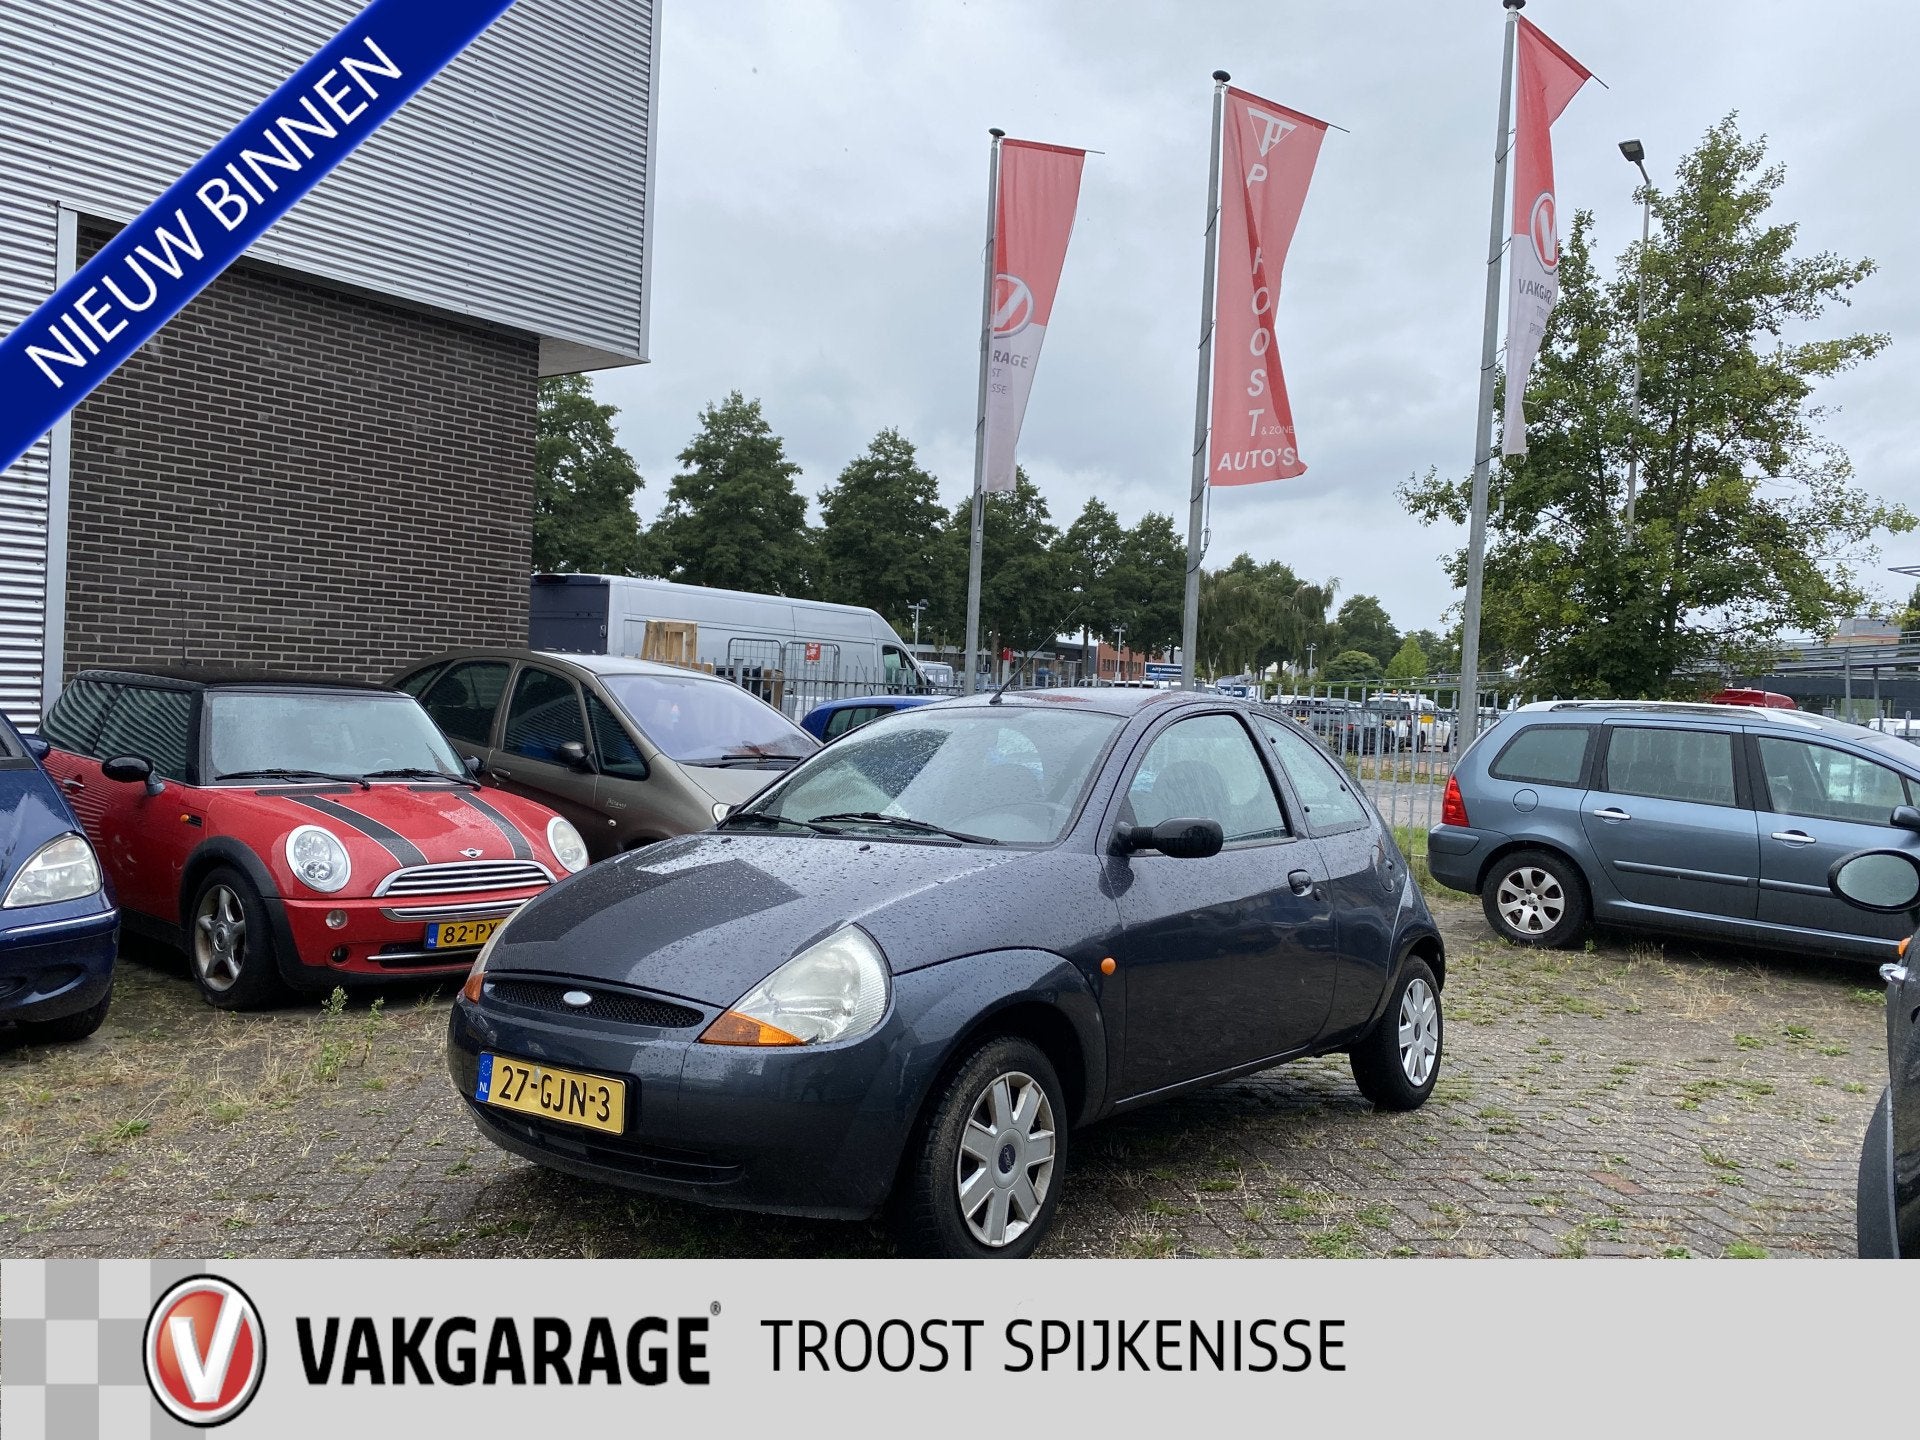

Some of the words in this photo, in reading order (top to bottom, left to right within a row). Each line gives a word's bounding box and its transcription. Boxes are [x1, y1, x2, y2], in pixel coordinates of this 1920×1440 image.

[1217, 447, 1296, 471] AUTO'S
[479, 1081, 488, 1093] NL
[499, 1065, 611, 1122] 27-GJN-3
